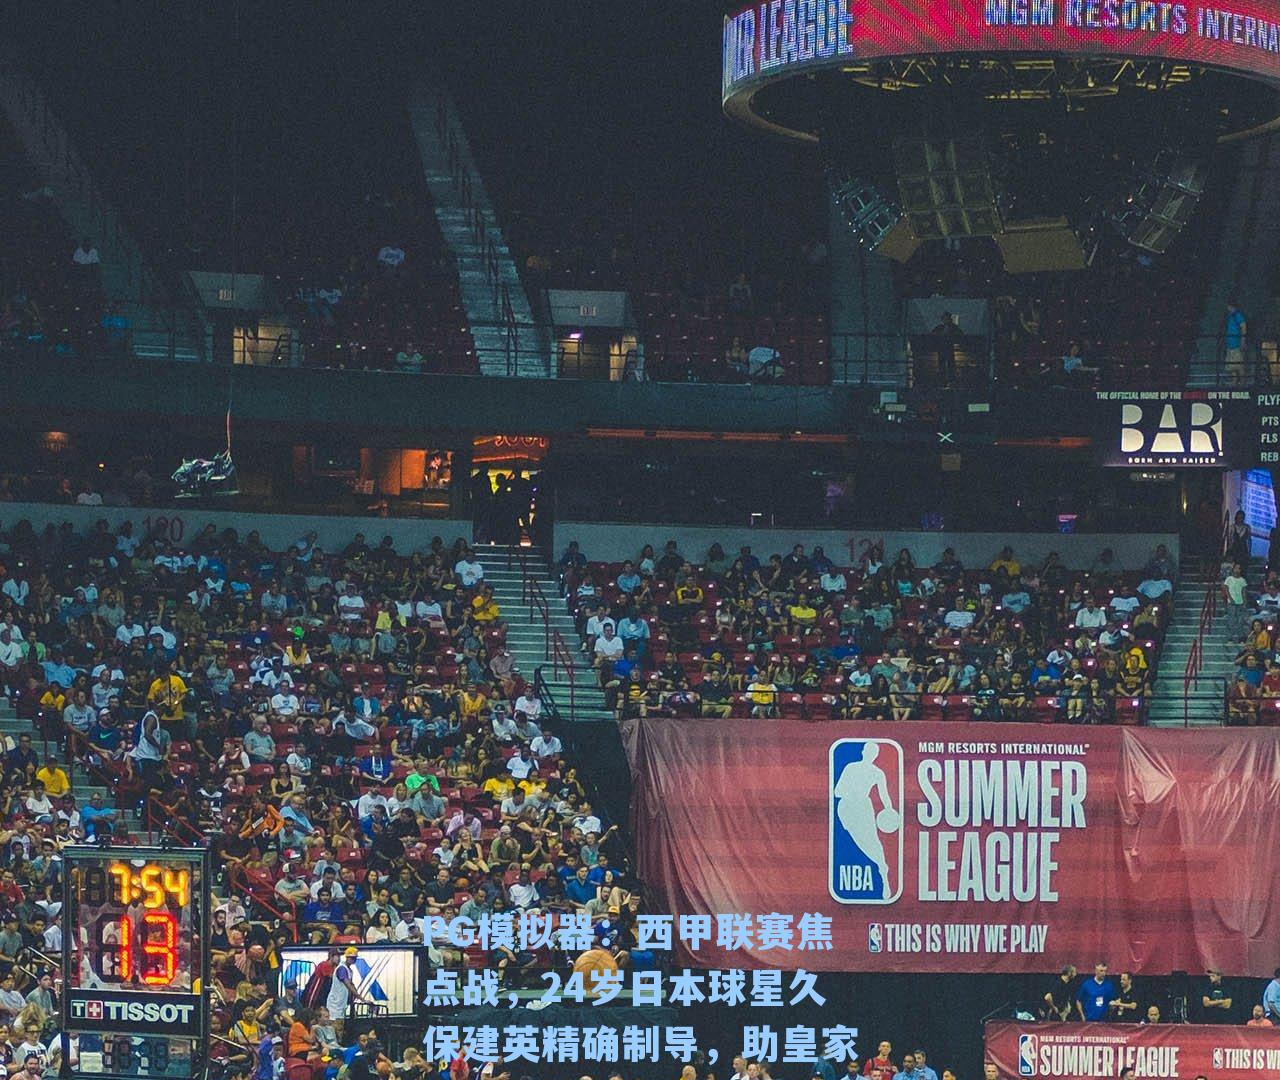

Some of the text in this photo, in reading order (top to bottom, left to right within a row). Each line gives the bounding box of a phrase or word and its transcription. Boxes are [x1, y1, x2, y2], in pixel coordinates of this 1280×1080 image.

[1261, 416, 1280, 427] PTS
[1261, 433, 1279, 444] FLS
[1260, 452, 1279, 462] REB
[918, 742, 999, 755] MGM RESORTS
[916, 759, 1088, 829] SUMMER
[839, 864, 874, 892] NBA
[917, 831, 1061, 902] LEAGUE
[109, 863, 189, 909] 7:54
[120, 912, 178, 985] 13
[884, 923, 1049, 954] THIS IS WHY WE PLAY
[107, 1003, 195, 1023] TISSOT
[1039, 1035, 1055, 1043] MGM
[1055, 1035, 1082, 1044] RESORTS
[1039, 1045, 1180, 1078] SUMMER LEAGUE
[1224, 1047, 1251, 1070] THIS
[1252, 1049, 1265, 1070] IS
